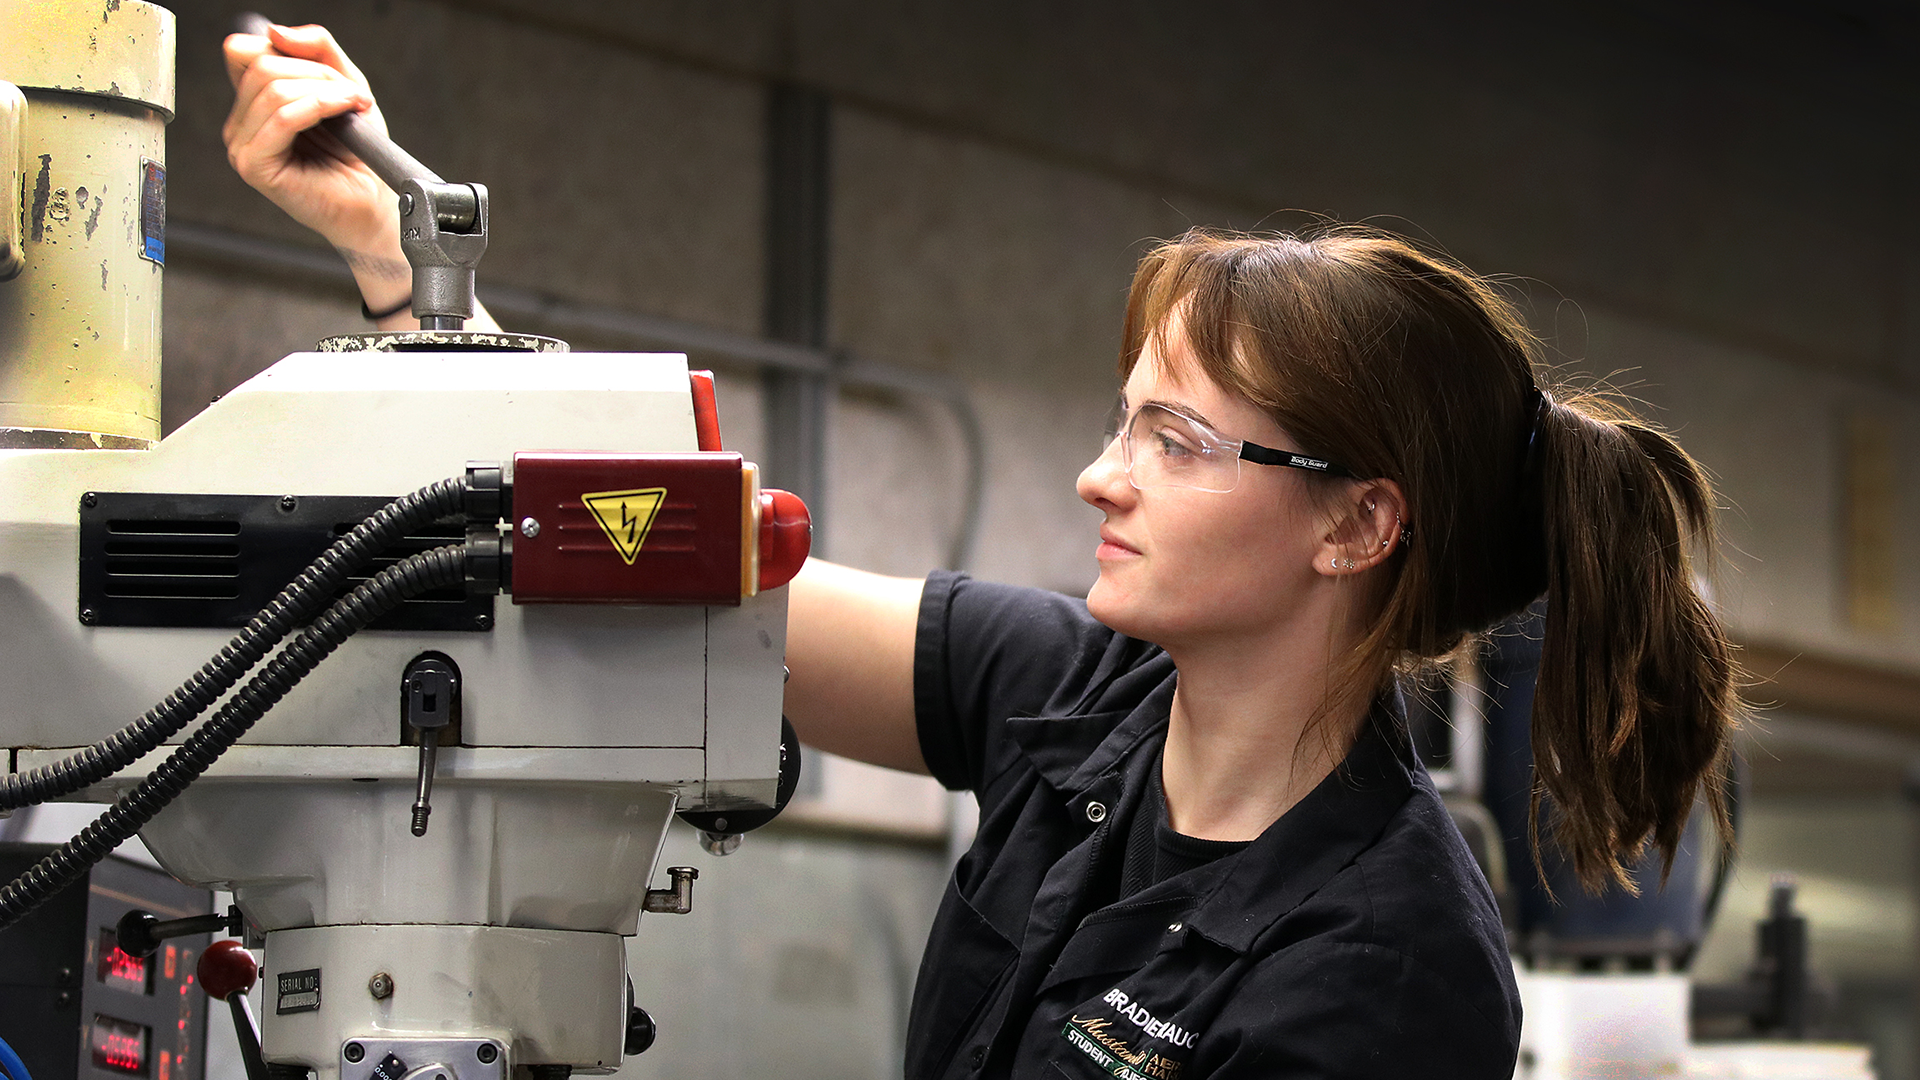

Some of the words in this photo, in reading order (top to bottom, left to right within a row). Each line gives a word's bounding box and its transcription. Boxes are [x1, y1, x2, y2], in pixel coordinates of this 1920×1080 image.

[1291, 456, 1308, 466] Body
[1308, 459, 1329, 469] Guard
[280, 977, 302, 992] SERIAL
[1067, 1029, 1115, 1067] STUDENT
